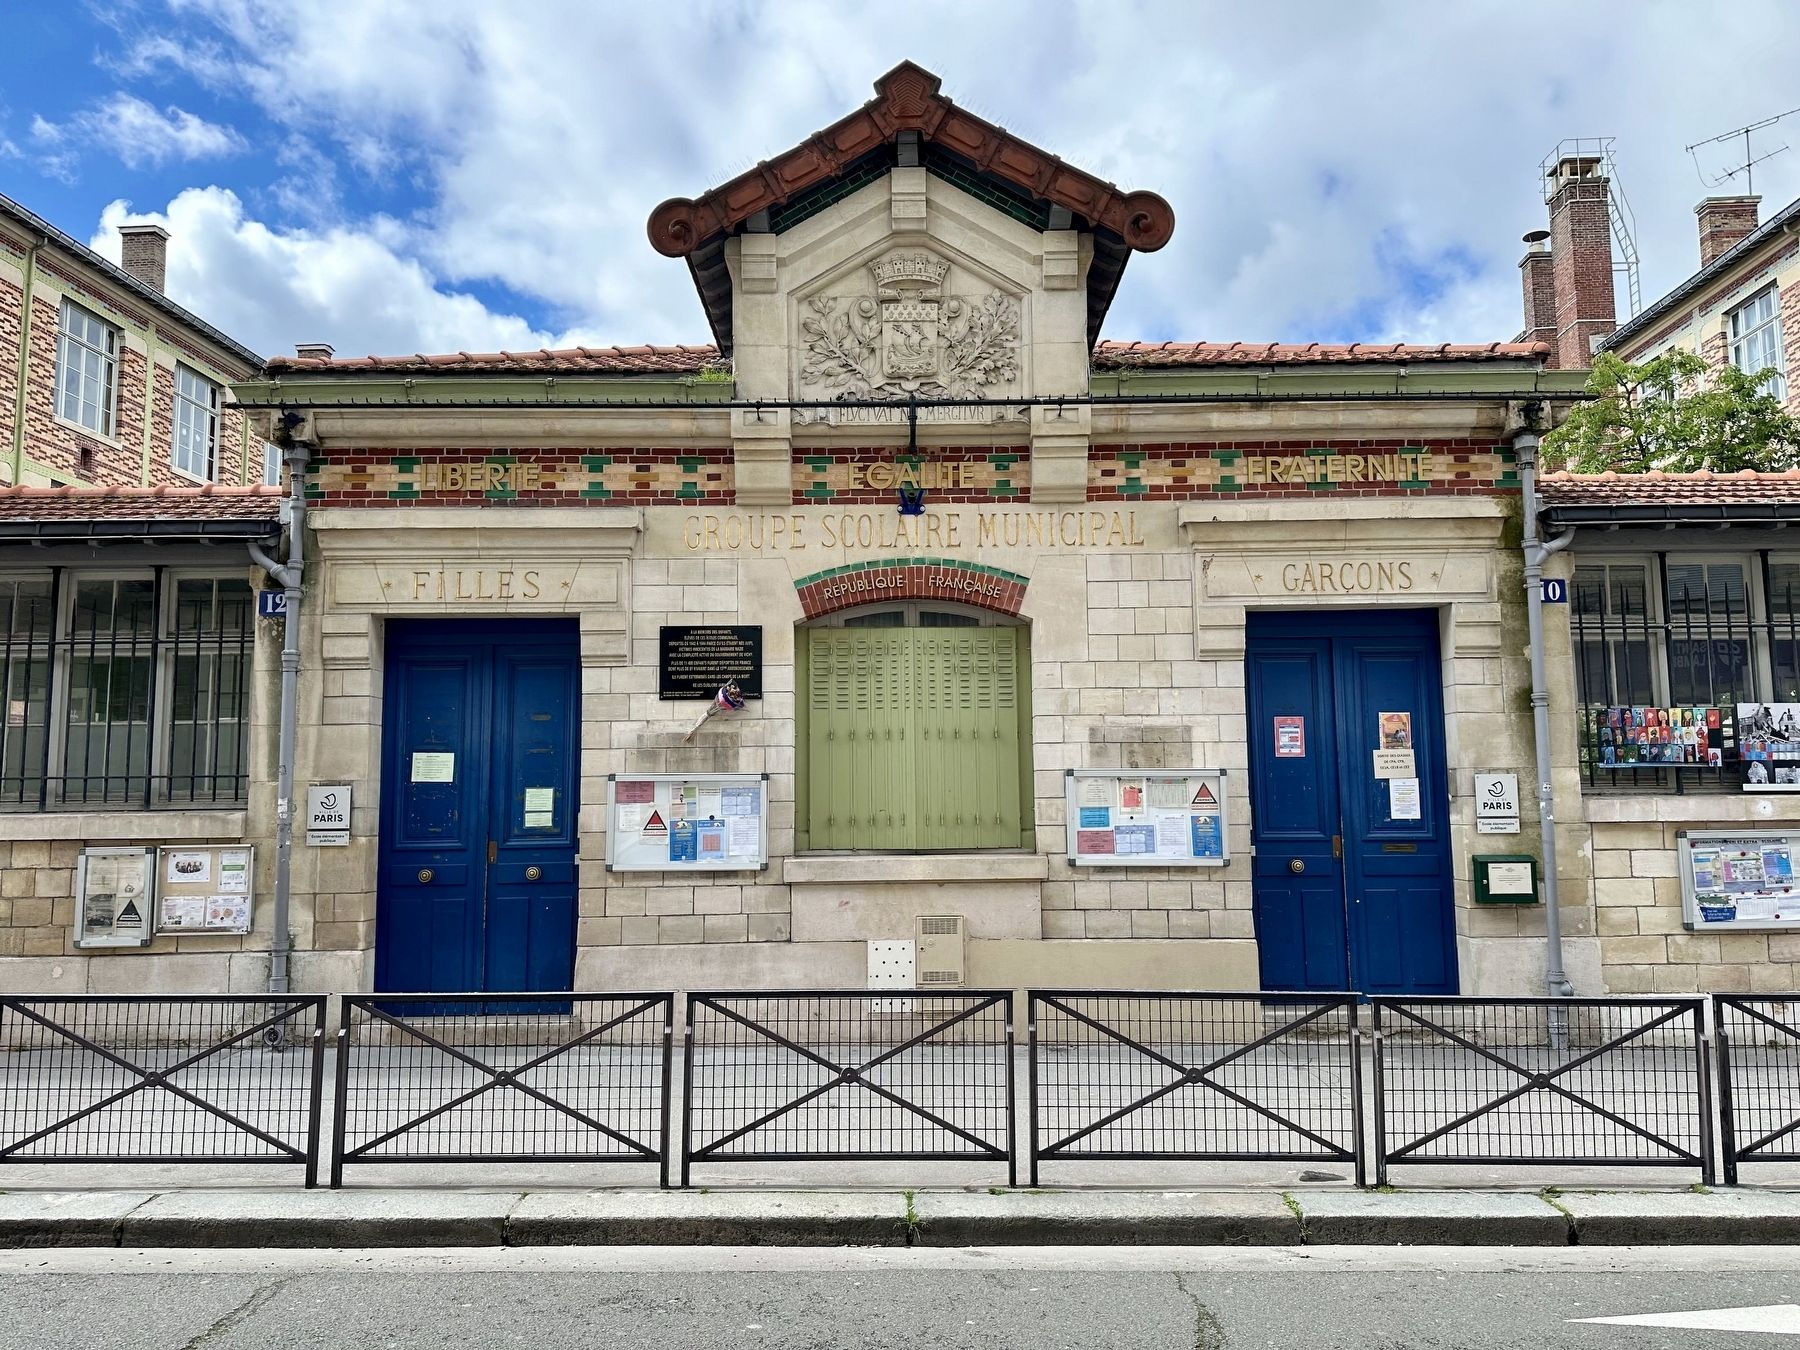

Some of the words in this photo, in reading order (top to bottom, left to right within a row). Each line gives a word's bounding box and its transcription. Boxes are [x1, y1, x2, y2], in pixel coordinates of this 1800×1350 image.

[420, 455, 540, 491] LIBERTÉ
[848, 455, 975, 489] ÉGALITÉ
[1246, 446, 1433, 484] FRATERNITÉ
[683, 515, 806, 551] GROUPE
[821, 513, 962, 549] SCOLAIRE
[977, 510, 1146, 548] MUNICIPAL
[412, 570, 541, 601] FILLES
[824, 575, 904, 600] RÉPUBLIQUE
[928, 575, 1002, 598] FRANÇAISE
[265, 593, 287, 613] 12
[314, 814, 344, 822] PARIS
[1483, 802, 1512, 810] PARIS
